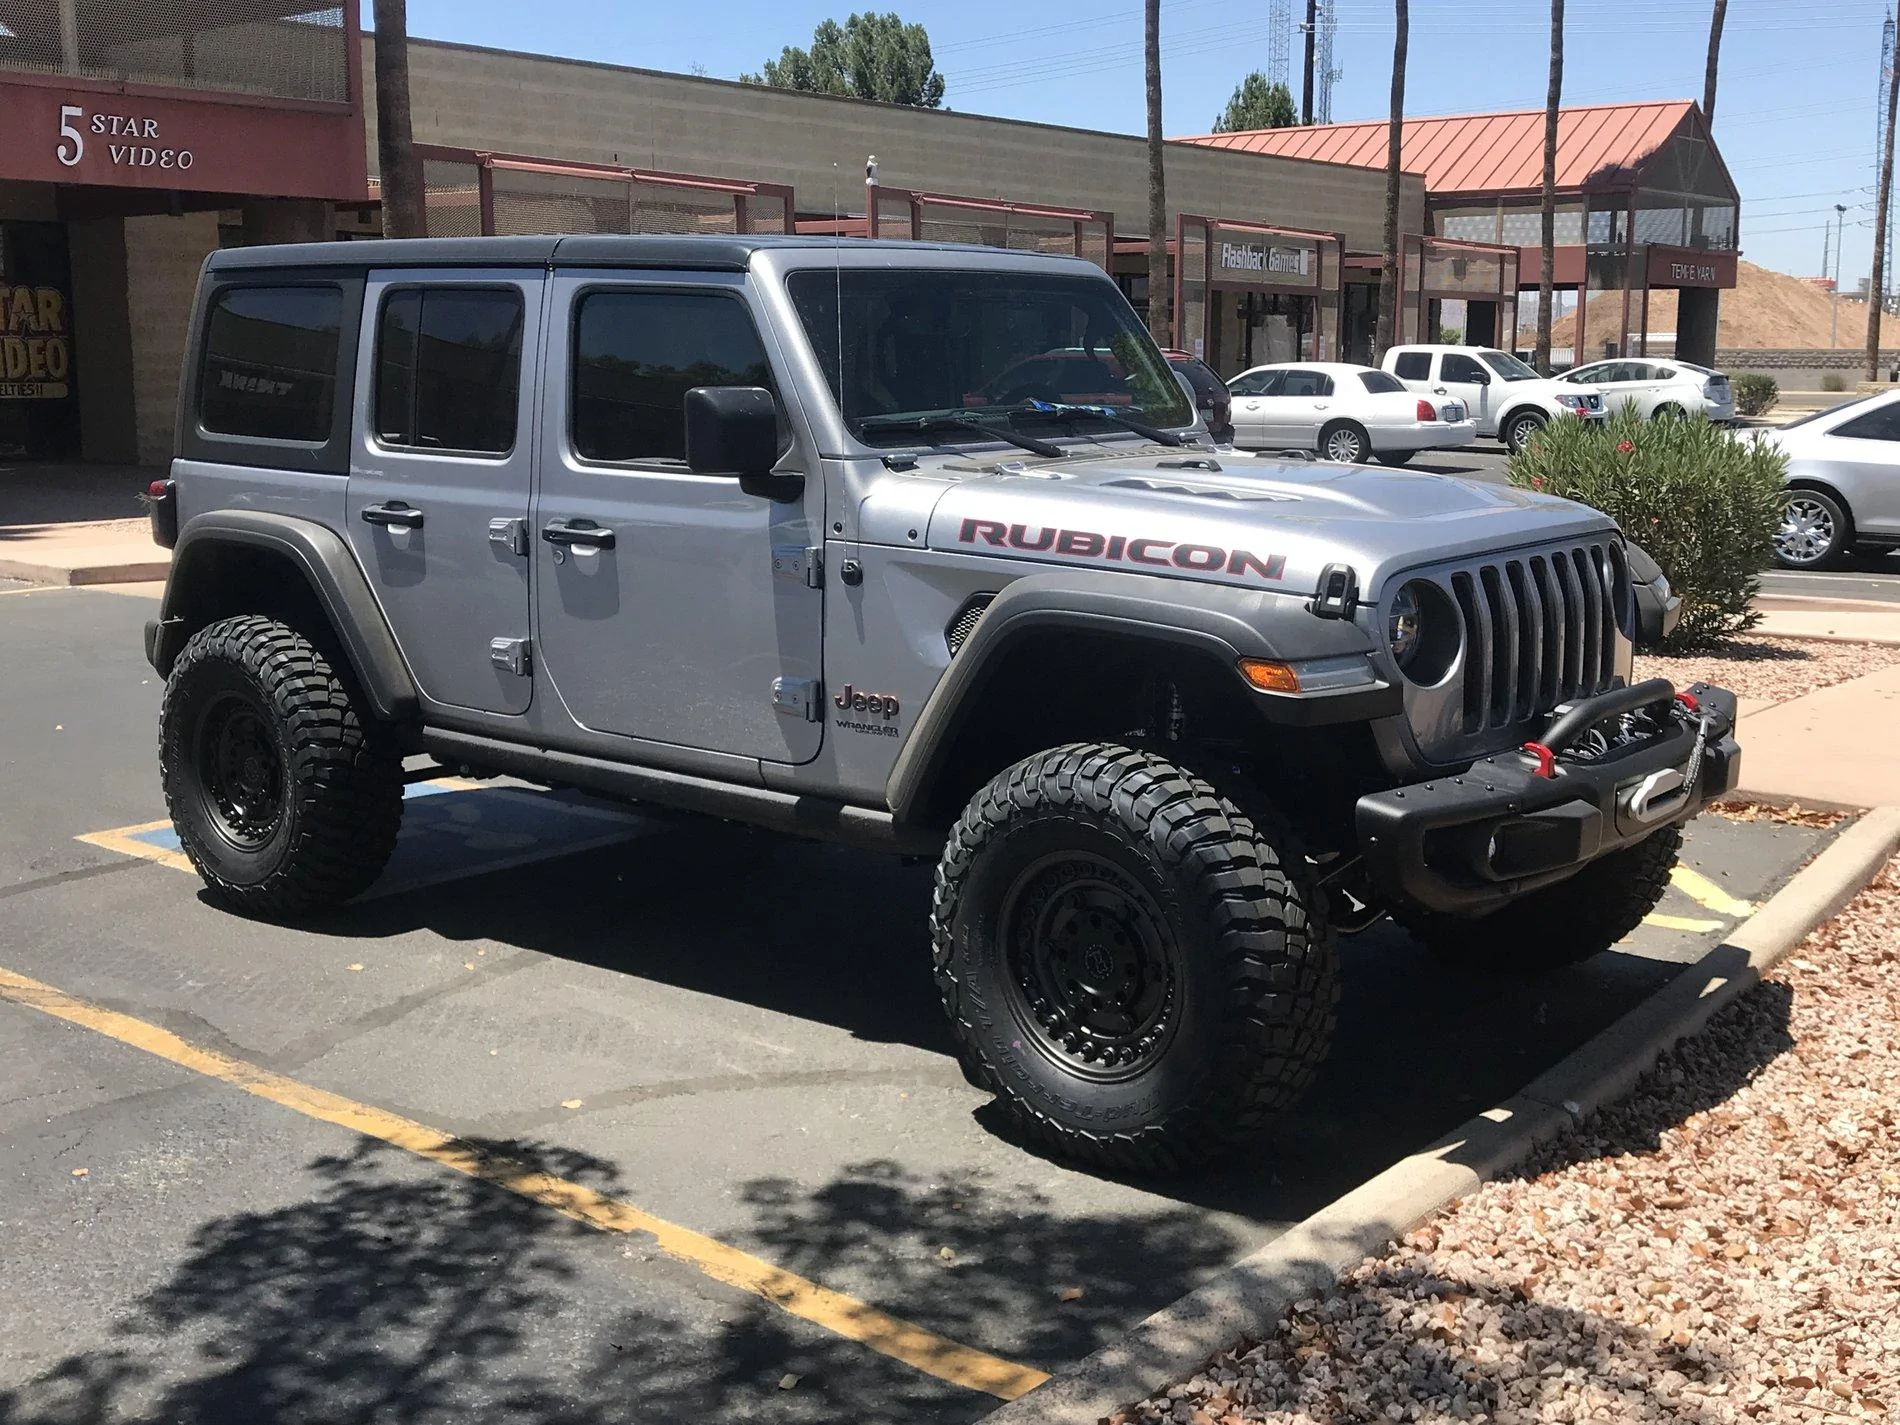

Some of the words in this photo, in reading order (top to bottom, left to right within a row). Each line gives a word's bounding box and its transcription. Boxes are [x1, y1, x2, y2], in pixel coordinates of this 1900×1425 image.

[57, 105, 84, 166] 5
[90, 114, 160, 139] STAR
[108, 144, 194, 170] VIDEO
[1221, 243, 1268, 271] Flashback
[1269, 248, 1299, 273] Games
[957, 517, 1287, 580] RUBICON
[834, 683, 900, 721] Jeep
[835, 719, 899, 734] WRANGLER
